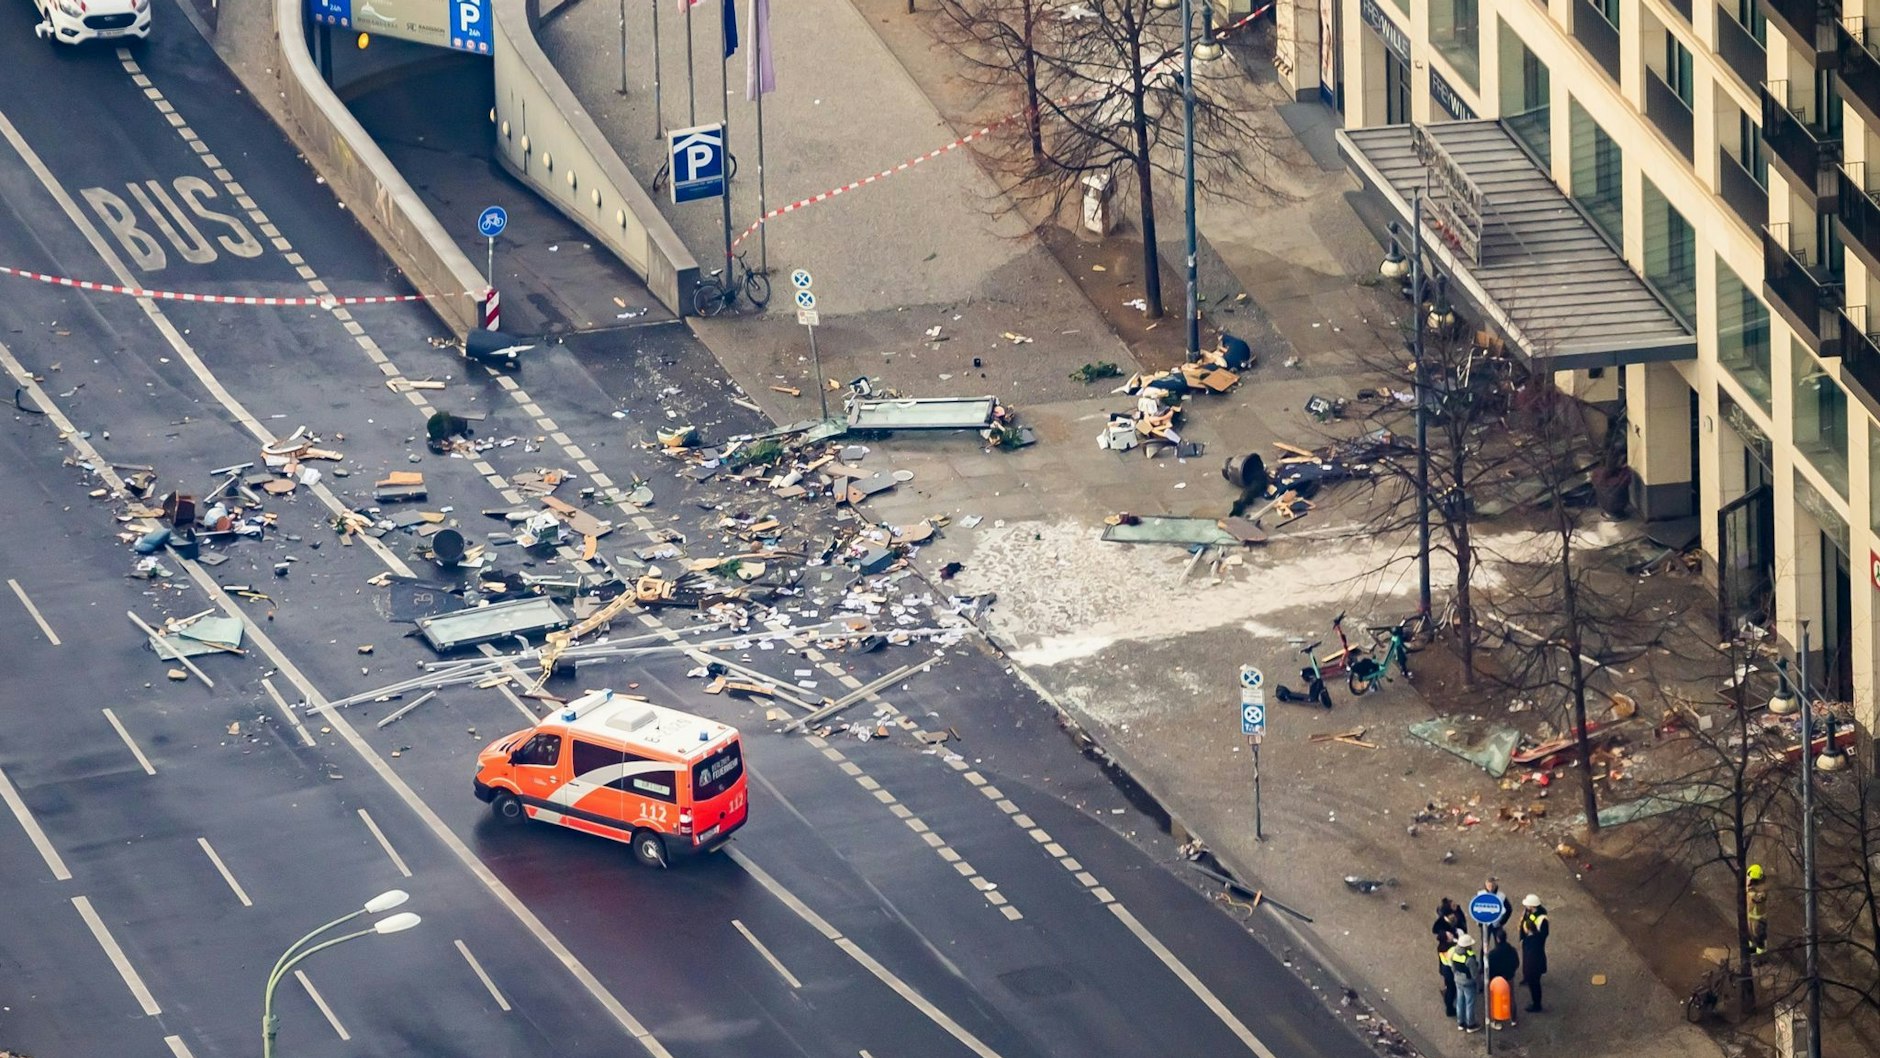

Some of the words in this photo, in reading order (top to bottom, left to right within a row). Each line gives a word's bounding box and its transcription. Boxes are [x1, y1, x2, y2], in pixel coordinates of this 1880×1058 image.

[329, 3, 342, 13] 24h
[460, 2, 480, 32] P
[468, 28, 481, 37] 24h
[687, 144, 713, 181] P
[80, 175, 263, 272] BUS
[712, 757, 738, 781] FEUERWEHR
[639, 802, 667, 822] 112
[729, 794, 744, 814] 112
